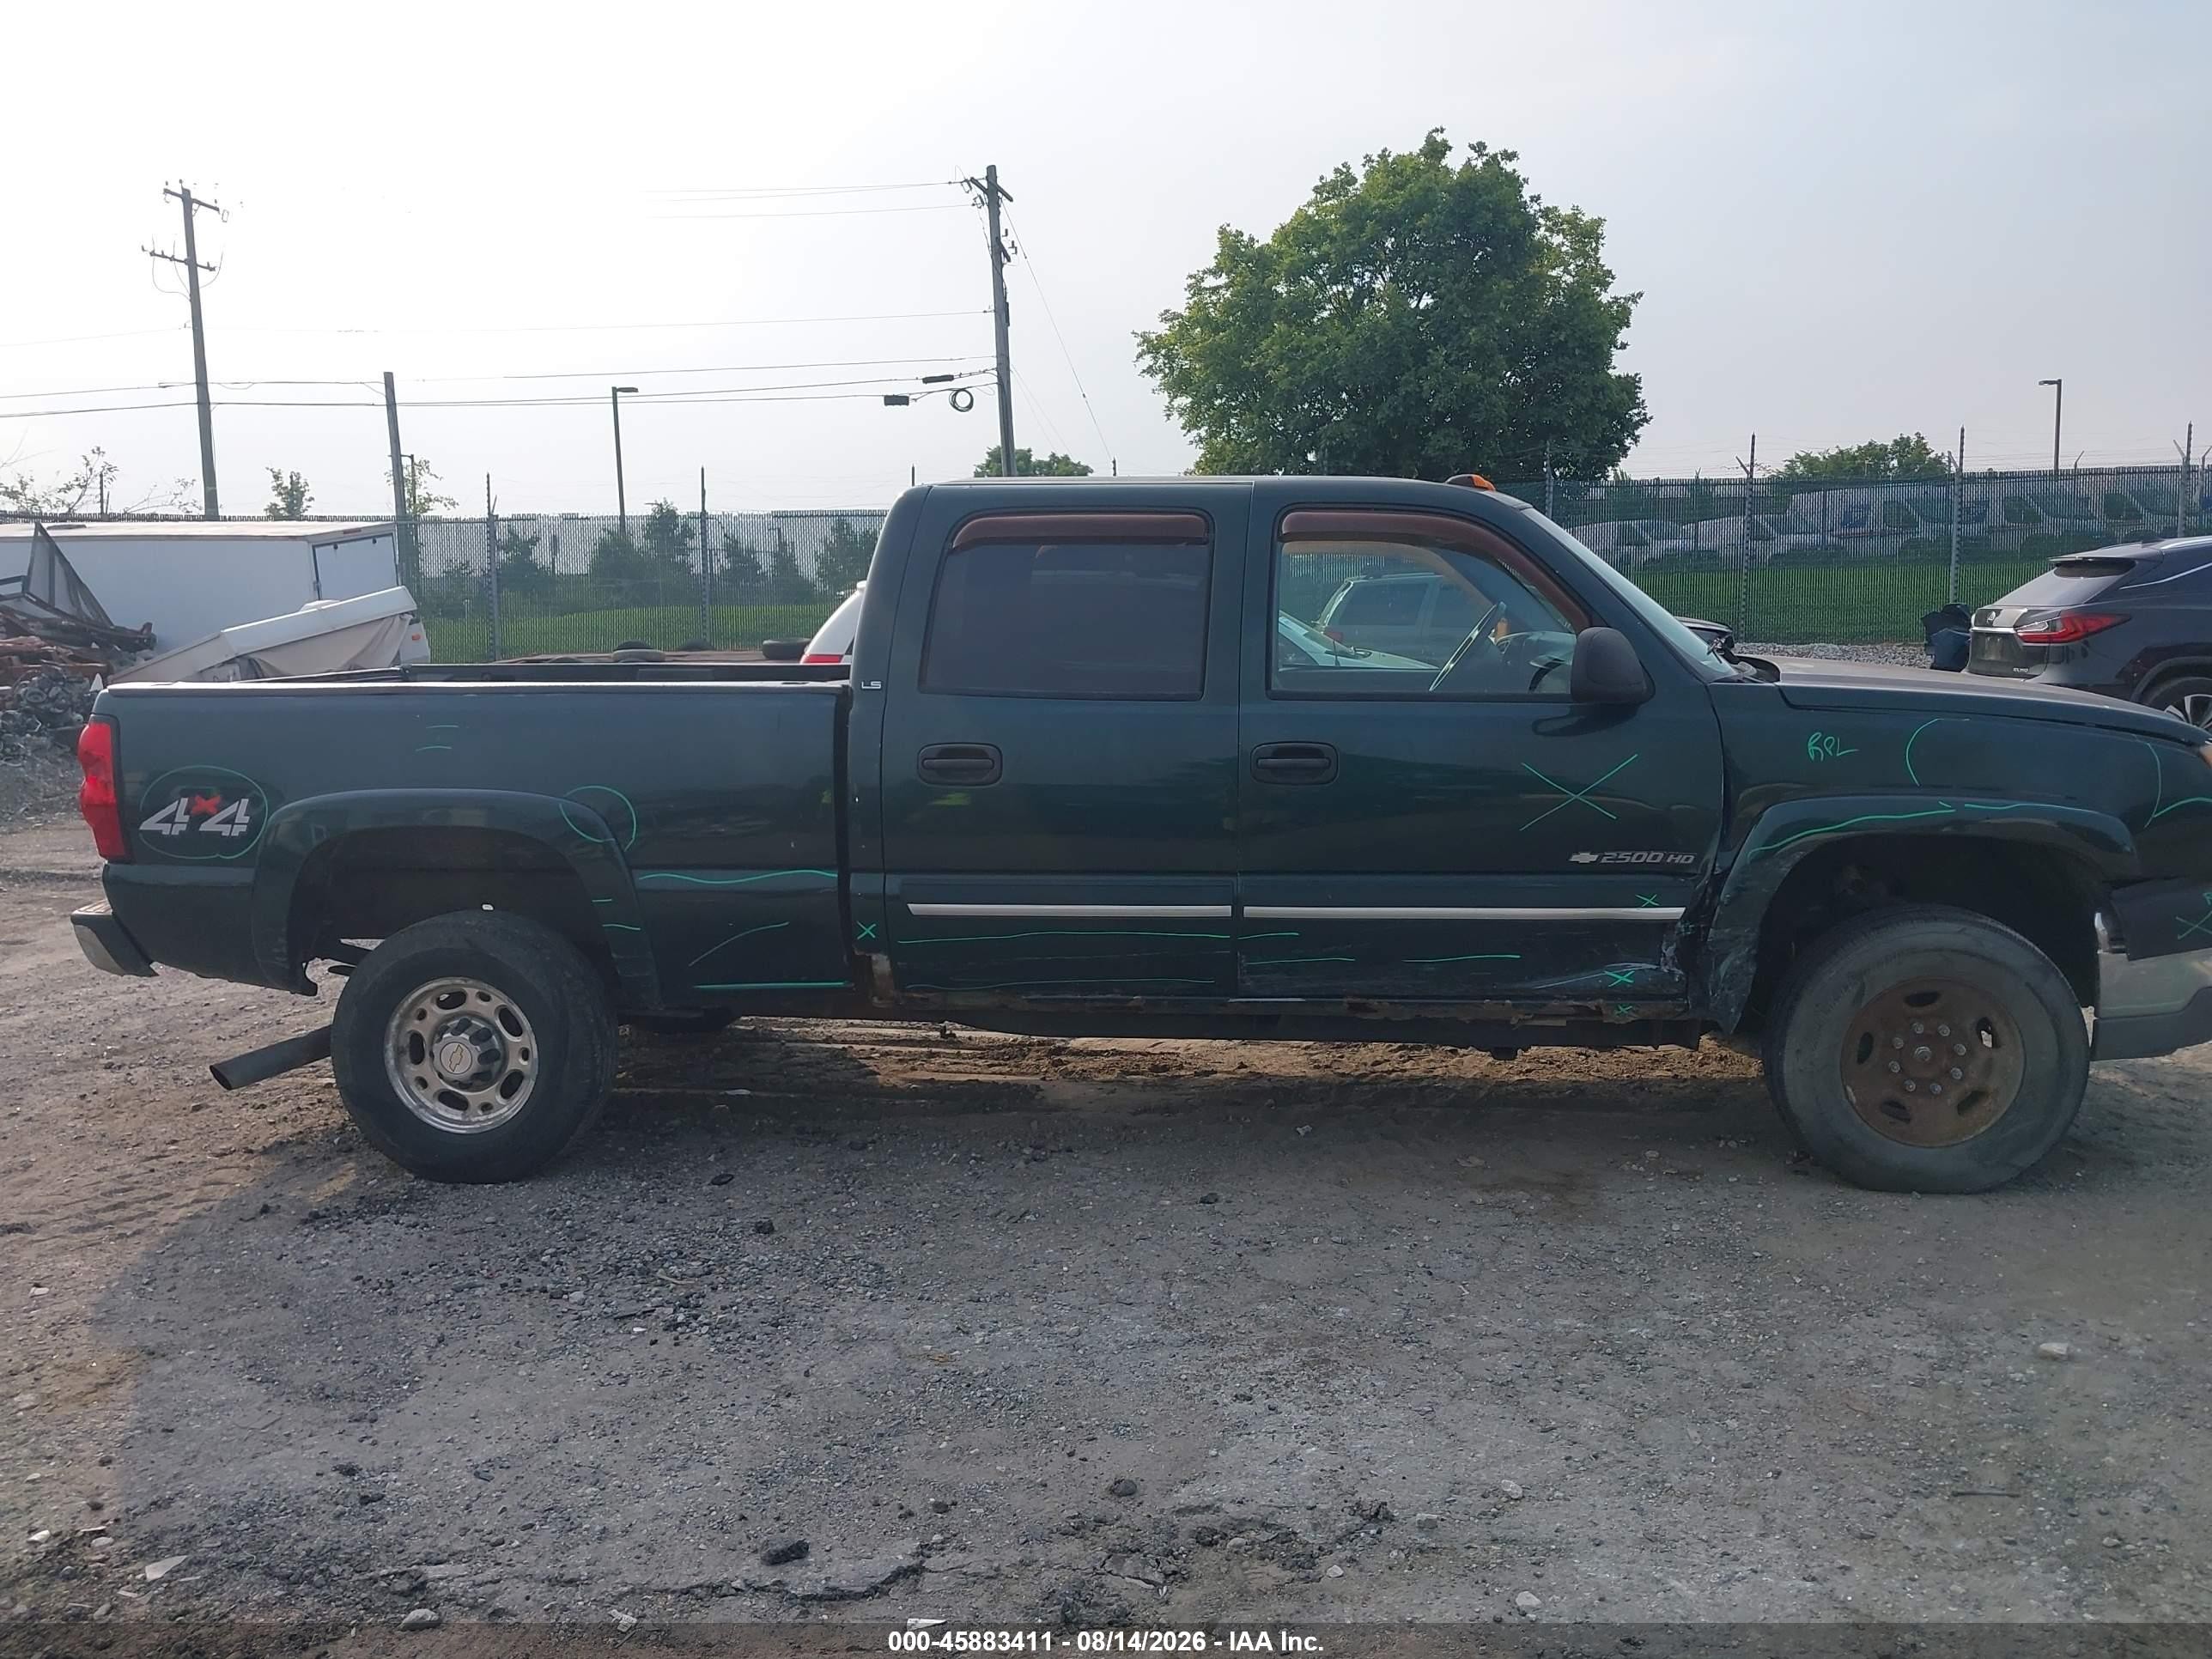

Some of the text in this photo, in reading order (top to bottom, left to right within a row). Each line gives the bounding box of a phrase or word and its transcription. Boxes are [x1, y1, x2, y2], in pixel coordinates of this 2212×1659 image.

[861, 681, 881, 690] LS
[1601, 852, 1695, 864] 2500 HD
